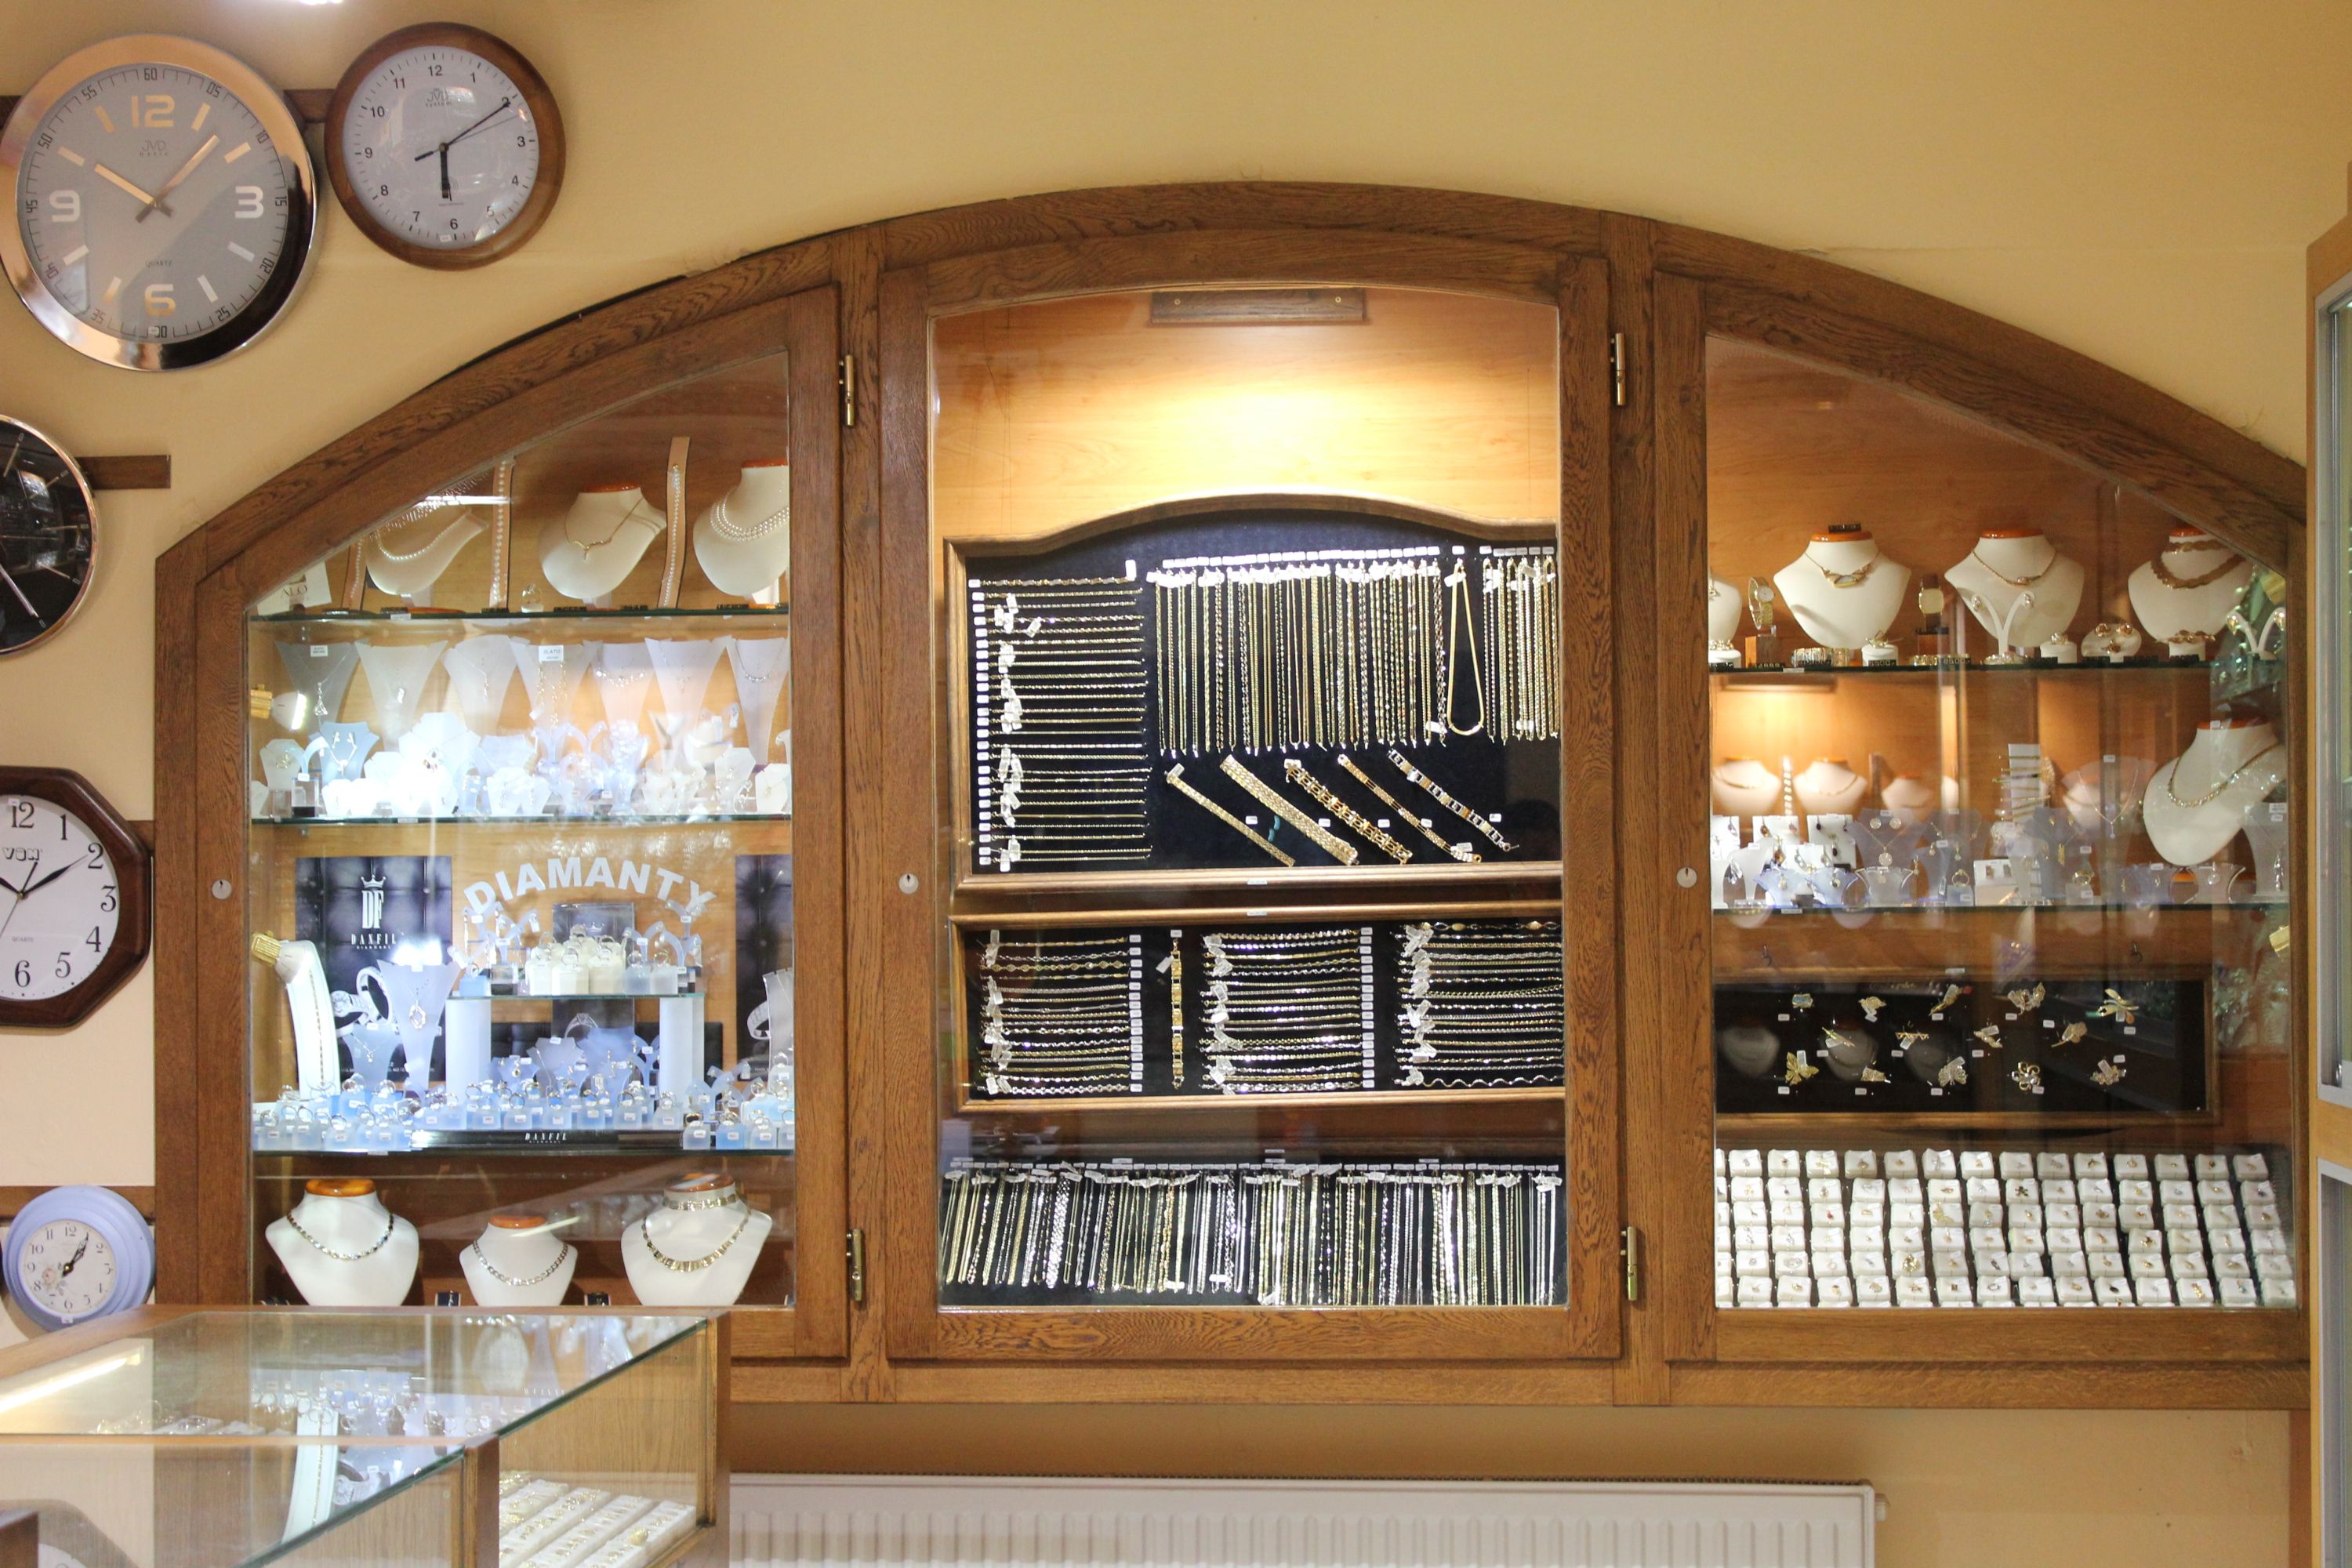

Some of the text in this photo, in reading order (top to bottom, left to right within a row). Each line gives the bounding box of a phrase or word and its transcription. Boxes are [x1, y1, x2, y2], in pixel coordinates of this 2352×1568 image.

[144, 68, 157, 80] 60
[428, 65, 442, 76] 12
[470, 72, 476, 82] 1
[206, 82, 222, 97] 05
[394, 78, 405, 89] 11
[82, 85, 97, 100] 55
[131, 94, 175, 128] 12
[371, 107, 384, 117] 10
[38, 133, 53, 149] 50
[256, 129, 270, 143] 10
[517, 136, 525, 147] 3
[365, 147, 372, 158] 9
[512, 176, 519, 186] 4
[380, 185, 388, 195] 8
[26, 200, 38, 213] 45
[49, 190, 80, 223] 9
[235, 186, 263, 219] 3
[275, 196, 287, 206] 15
[413, 211, 420, 221] 7
[487, 205, 495, 216] 5
[450, 219, 458, 230] 6
[45, 263, 59, 279] 40
[260, 258, 274, 274] 20
[144, 284, 176, 317] 6
[90, 307, 107, 324] 35
[216, 306, 230, 321] 25
[12, 801, 34, 828] 12
[60, 814, 67, 840] 1
[88, 842, 104, 869] 2
[464, 857, 717, 916] DIAMANTY
[100, 885, 116, 912] 3
[361, 890, 384, 929] DF
[85, 926, 101, 953] 4
[351, 933, 396, 945] DANFIL
[55, 952, 71, 978] 5
[15, 960, 31, 987] 6
[524, 1132, 566, 1141] DANFIL
[46, 1230, 53, 1240] 11
[64, 1226, 77, 1236] 12
[31, 1244, 44, 1254] 10
[27, 1262, 35, 1272] 9
[34, 1280, 42, 1291] 8
[64, 1299, 73, 1310] 6
